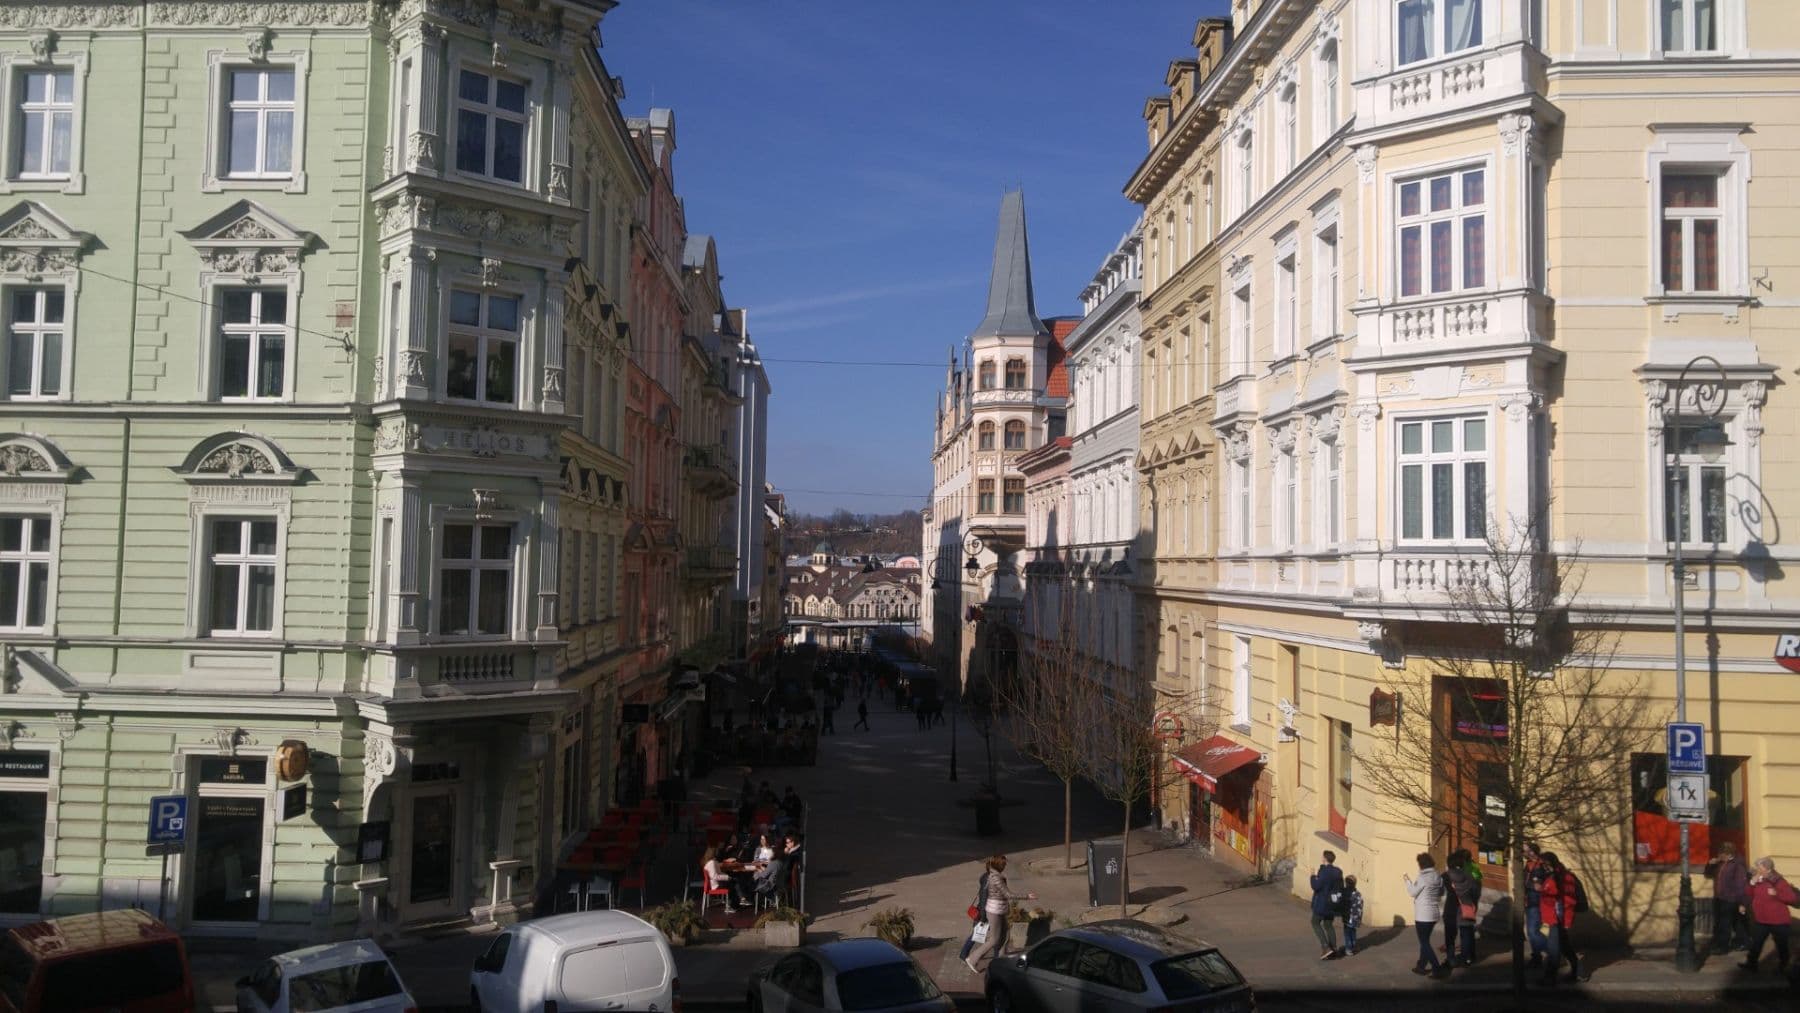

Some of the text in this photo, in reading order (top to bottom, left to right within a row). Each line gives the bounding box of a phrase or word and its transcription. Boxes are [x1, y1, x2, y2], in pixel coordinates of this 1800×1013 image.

[445, 431, 525, 452] HELIOS
[1776, 634, 1800, 657] R
[1675, 729, 1696, 757] P
[157, 802, 180, 829] P
